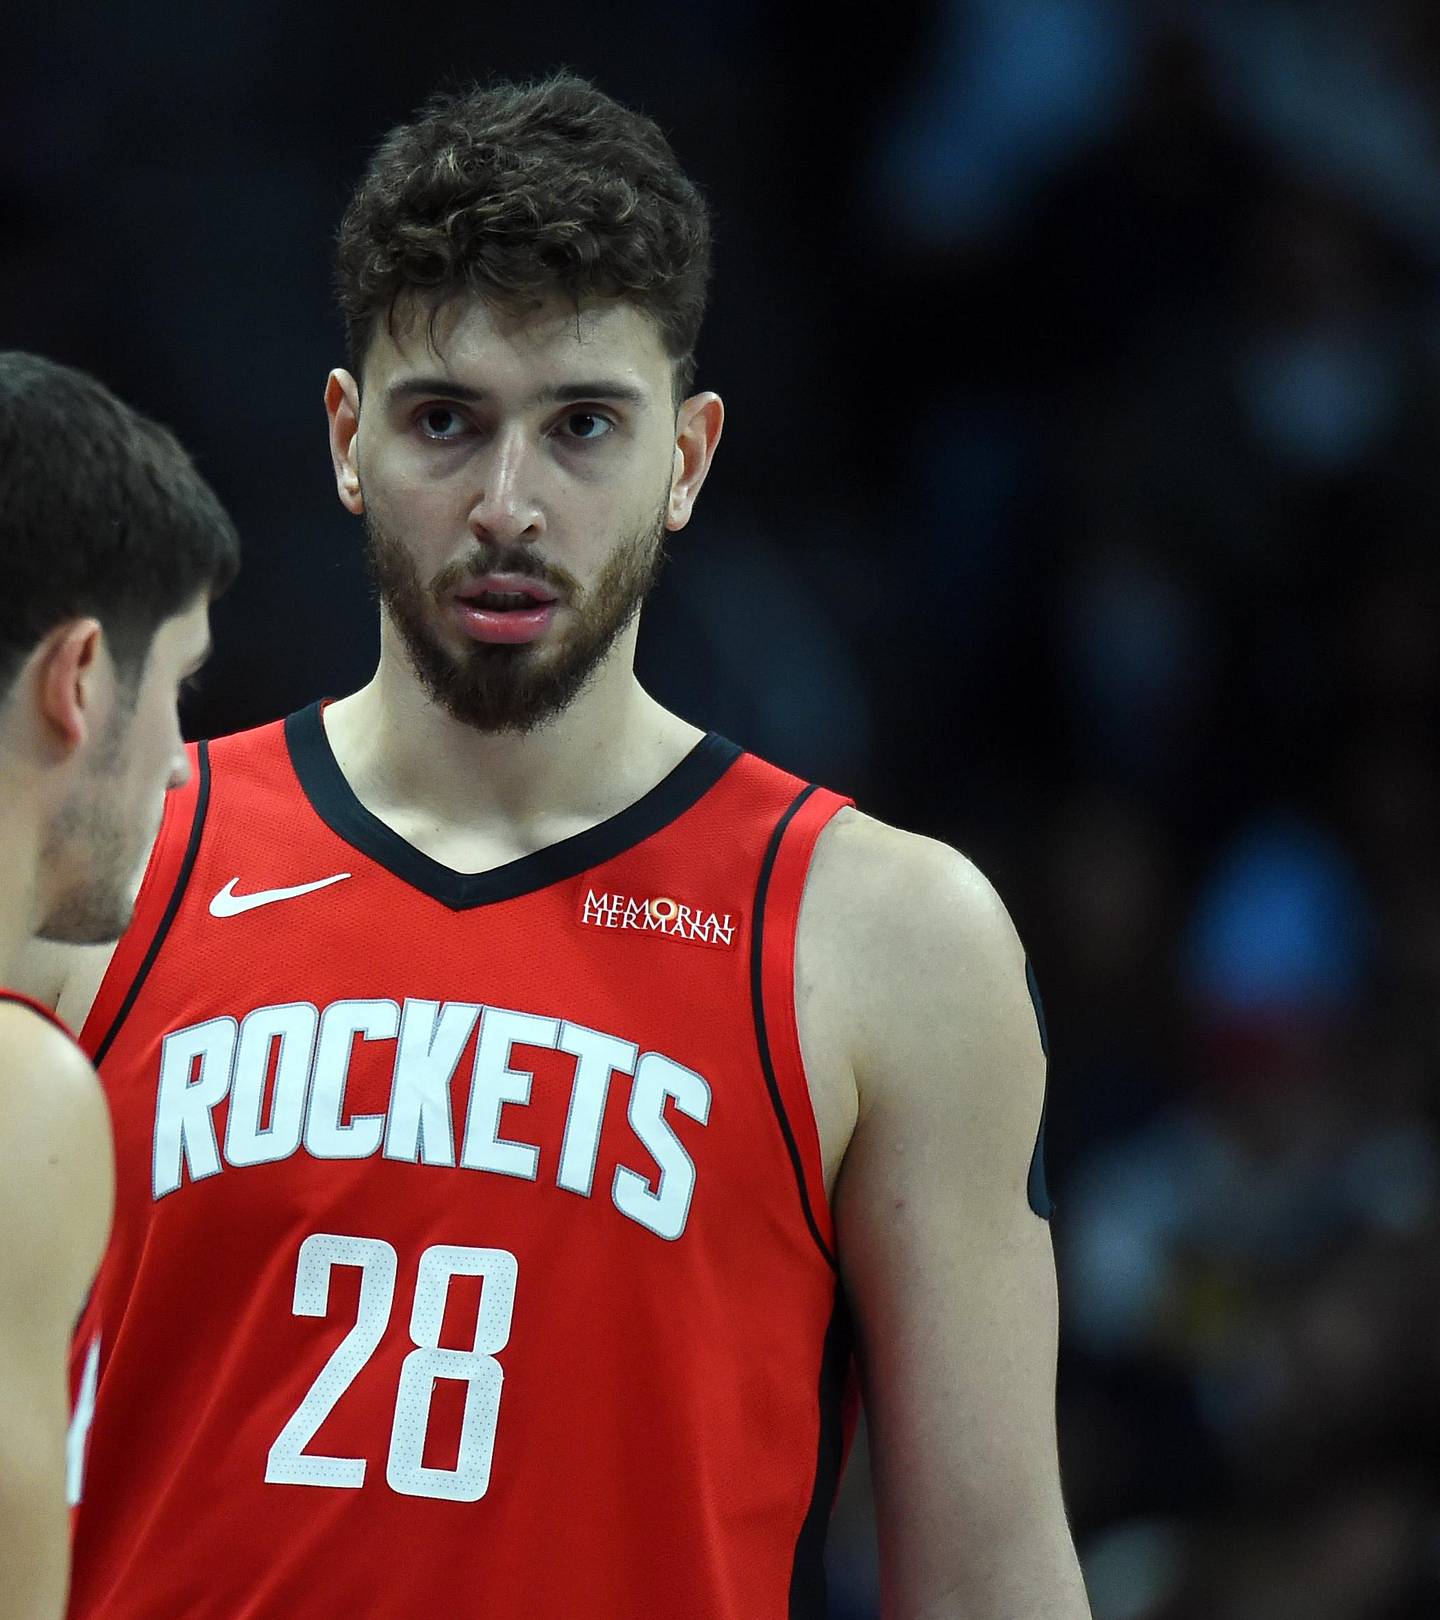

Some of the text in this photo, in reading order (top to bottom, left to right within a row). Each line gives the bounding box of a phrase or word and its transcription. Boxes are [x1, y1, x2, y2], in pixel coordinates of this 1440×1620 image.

[581, 902, 735, 945] HERMANN
[584, 888, 736, 931] MEMORIAL
[151, 996, 713, 1242] ROCKETS
[264, 1232, 519, 1503] 28
